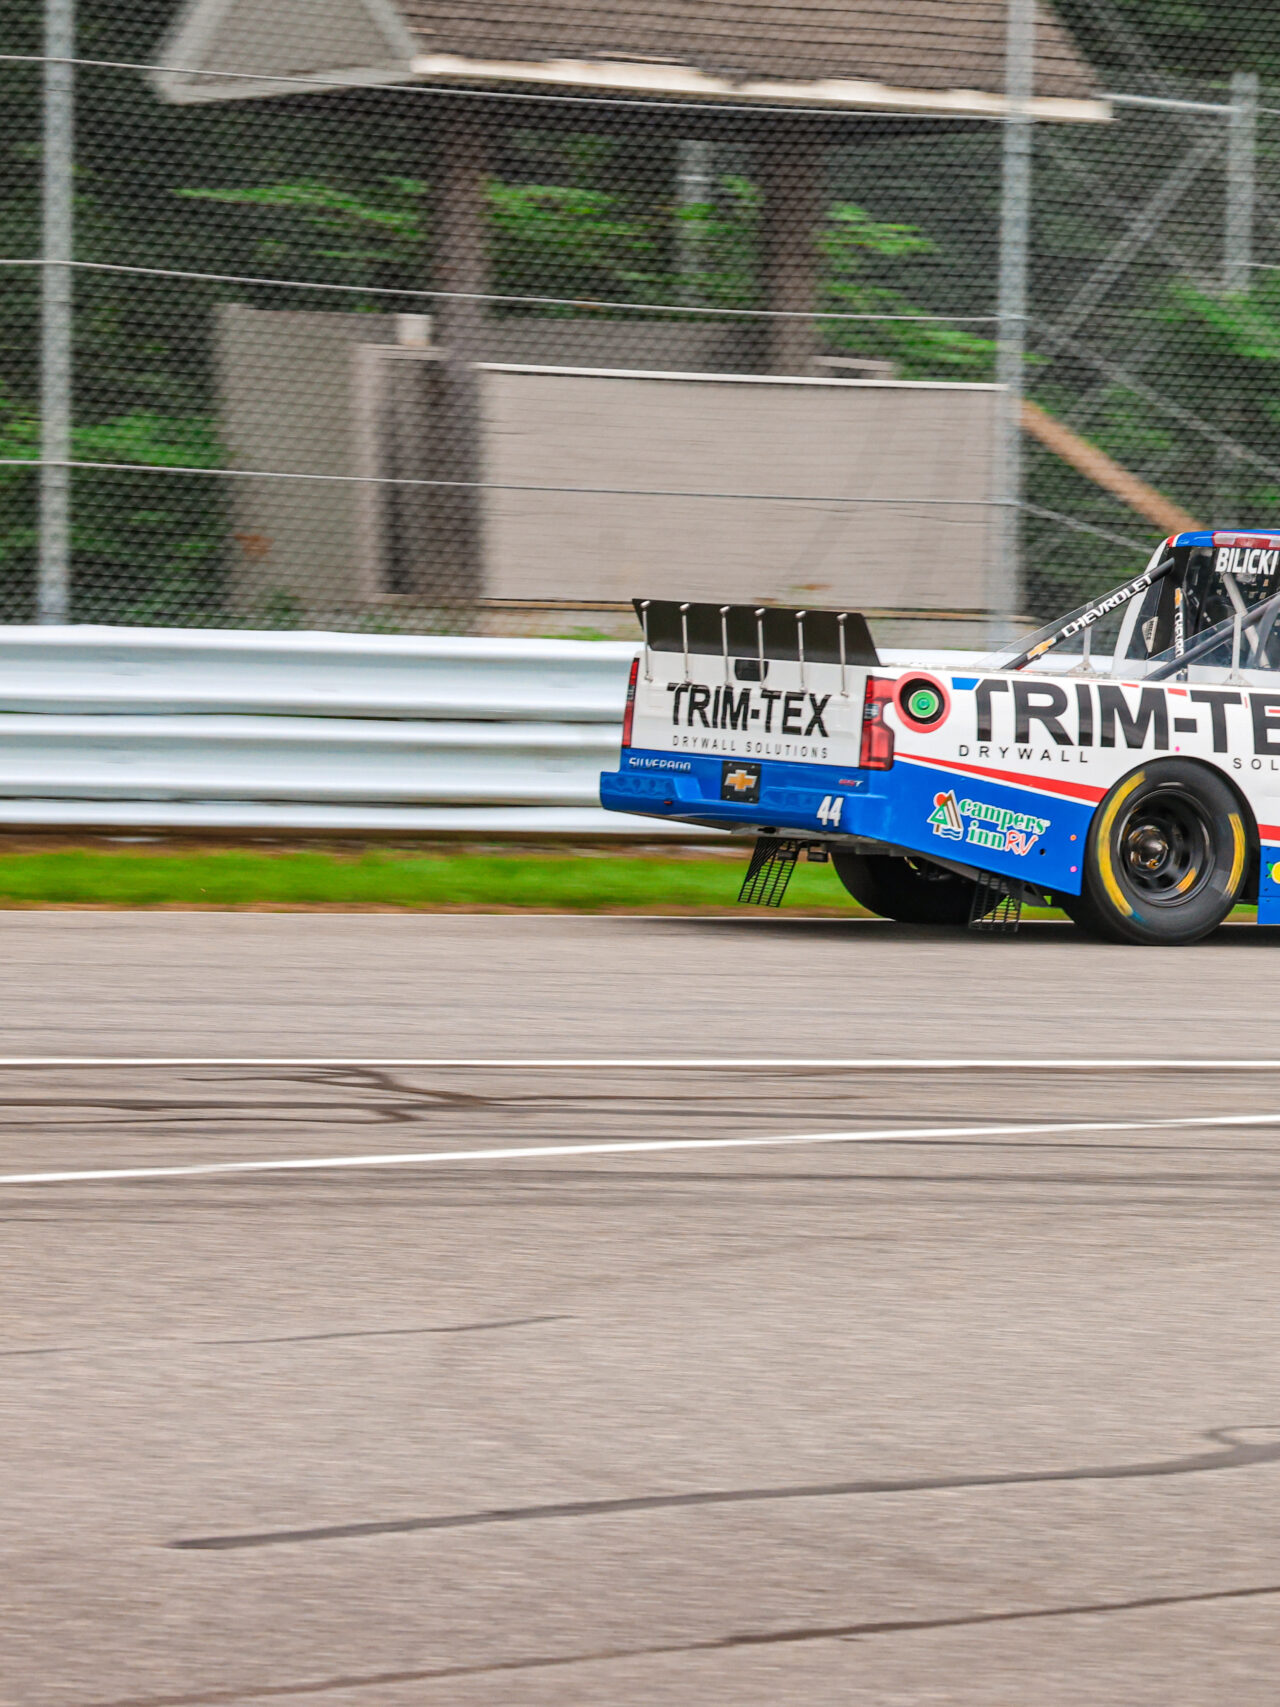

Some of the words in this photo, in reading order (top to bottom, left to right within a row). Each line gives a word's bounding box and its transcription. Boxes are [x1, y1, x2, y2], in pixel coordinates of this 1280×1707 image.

[1215, 547, 1279, 575] BILICKI
[1061, 575, 1152, 638] CHEVROLET
[666, 682, 832, 738] TRIM-TEX
[673, 735, 737, 752] DRYWALL
[746, 741, 828, 759] SOLUTIONS
[959, 745, 1089, 763] DRYWALL
[816, 795, 844, 827] 44
[959, 799, 1045, 834] campers
[967, 822, 1005, 850] inn
[1004, 831, 1038, 855] RV
